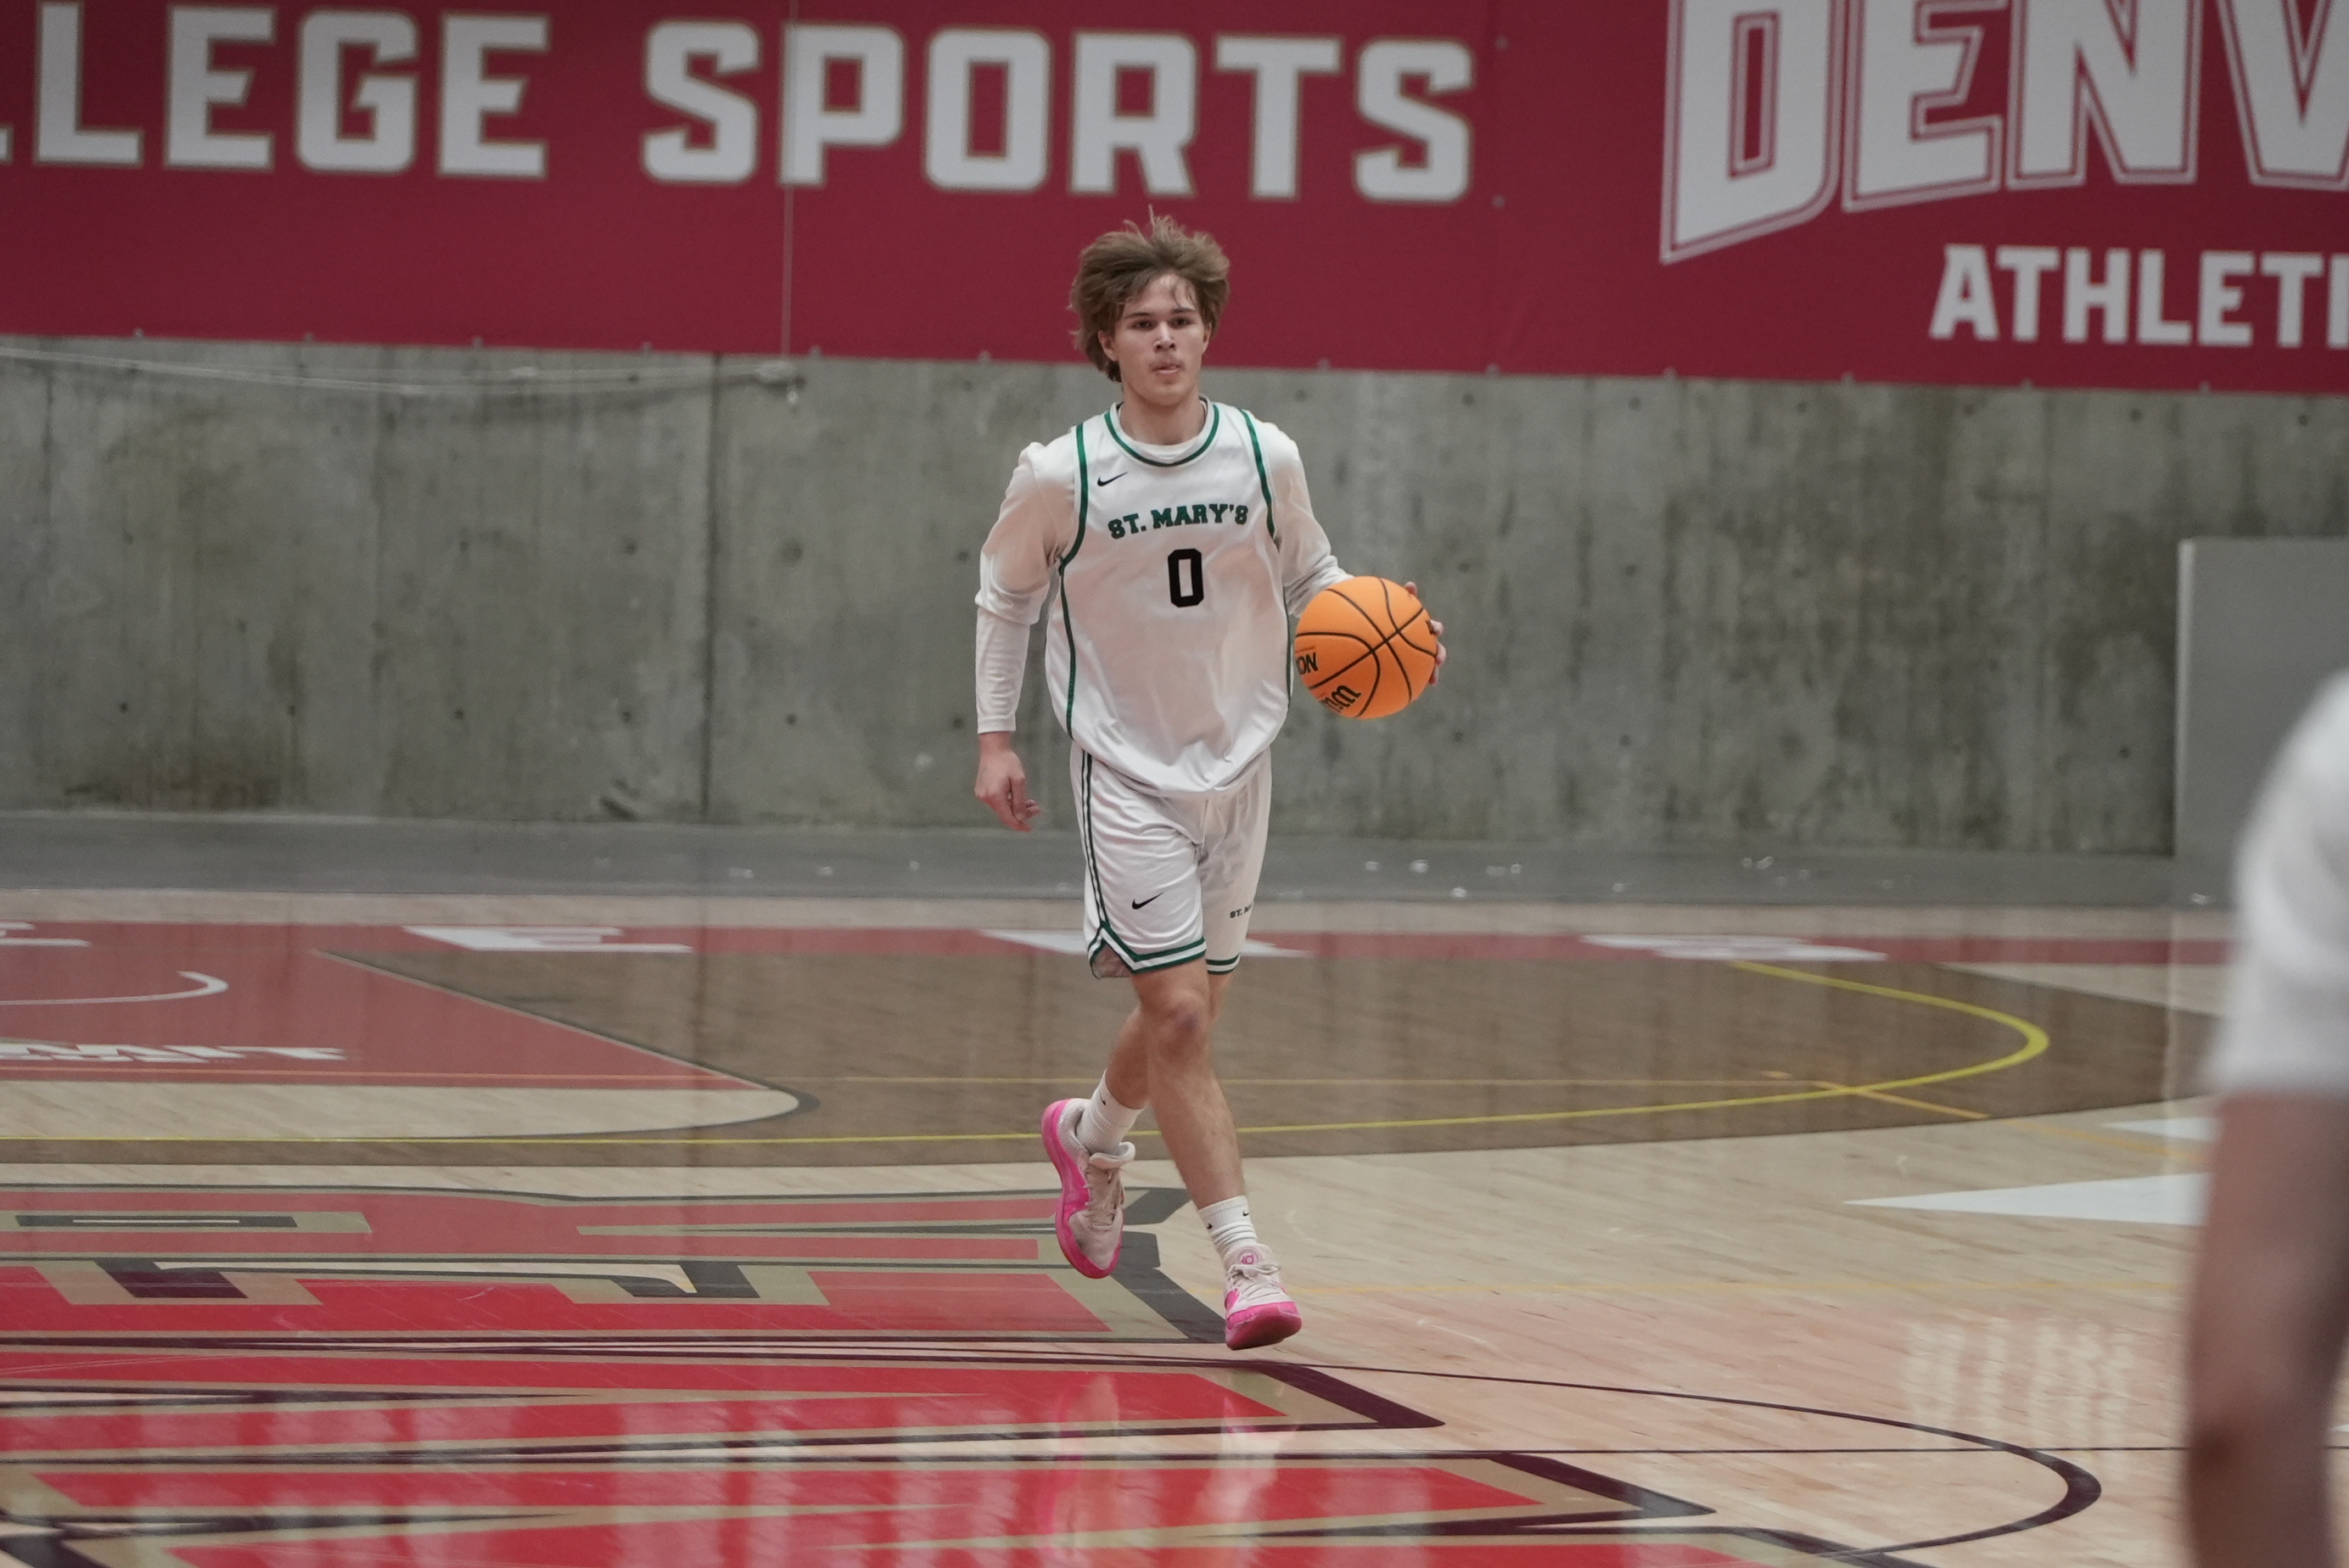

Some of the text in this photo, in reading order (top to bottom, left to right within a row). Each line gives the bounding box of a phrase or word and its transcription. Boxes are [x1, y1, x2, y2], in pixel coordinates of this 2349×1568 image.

[0, 2, 1475, 204] LEGE SPORTS
[1107, 503, 1249, 540] ST. MARY'S
[1168, 548, 1204, 608] 0
